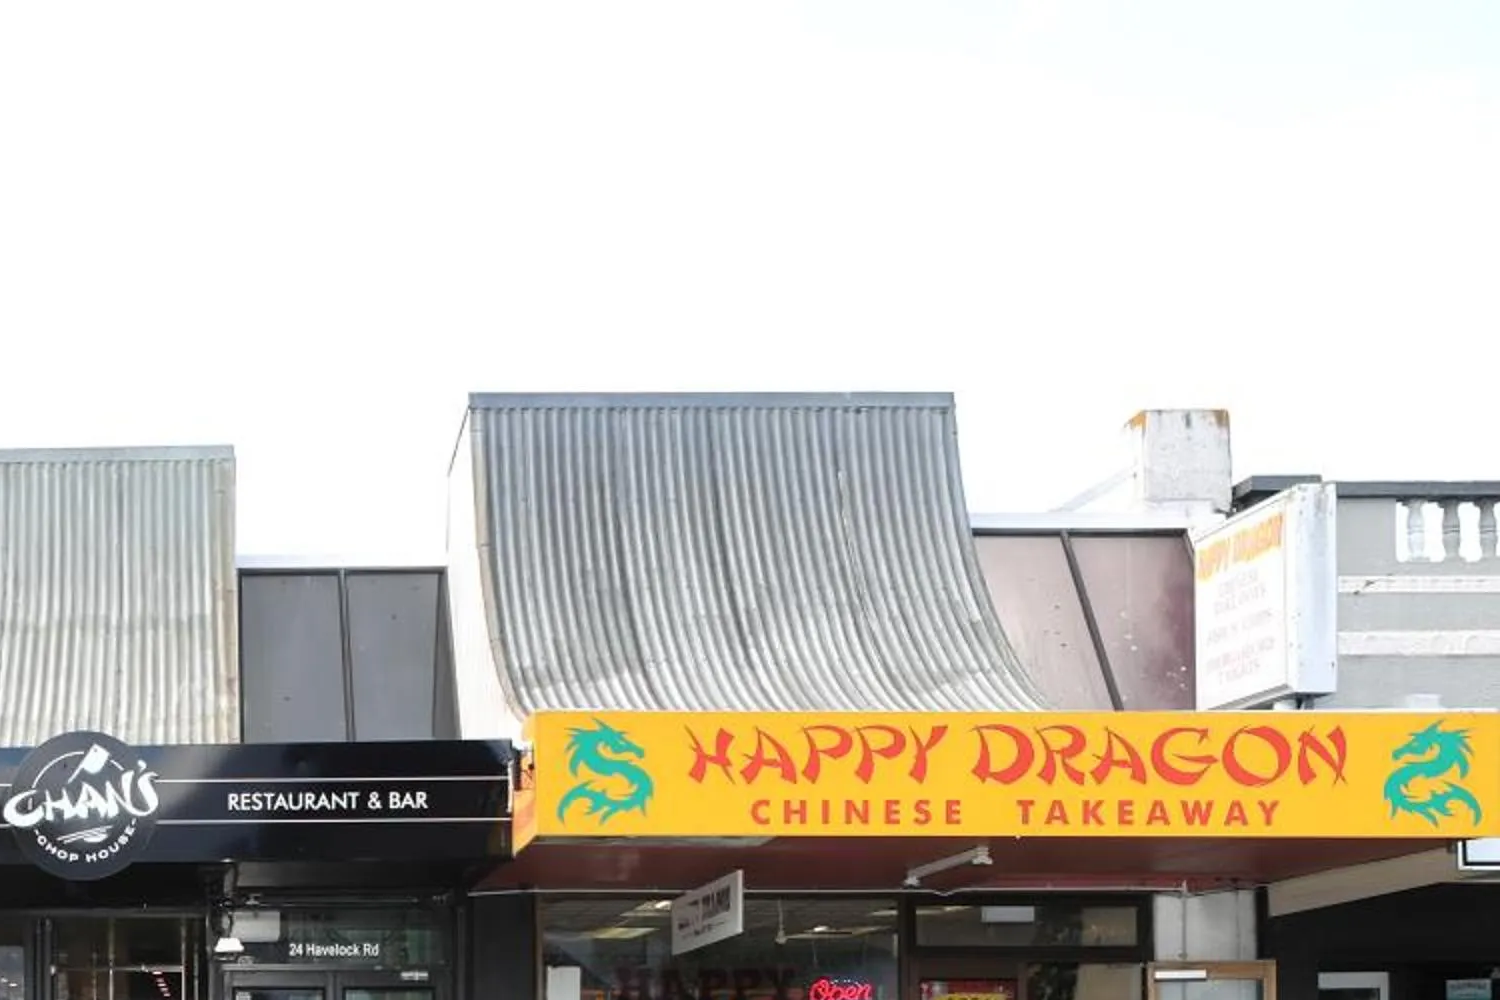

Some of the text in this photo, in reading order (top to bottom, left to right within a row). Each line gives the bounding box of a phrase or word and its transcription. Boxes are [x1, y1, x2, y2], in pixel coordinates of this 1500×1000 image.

[684, 723, 1348, 788] HAPPY DRAGON
[227, 791, 429, 812] RESTAURANT & BAR
[750, 799, 1281, 827] CHINESE TAKEAWAY
[85, 825, 136, 863] HOUSE
[289, 943, 380, 957] 24 Havelock Rd
